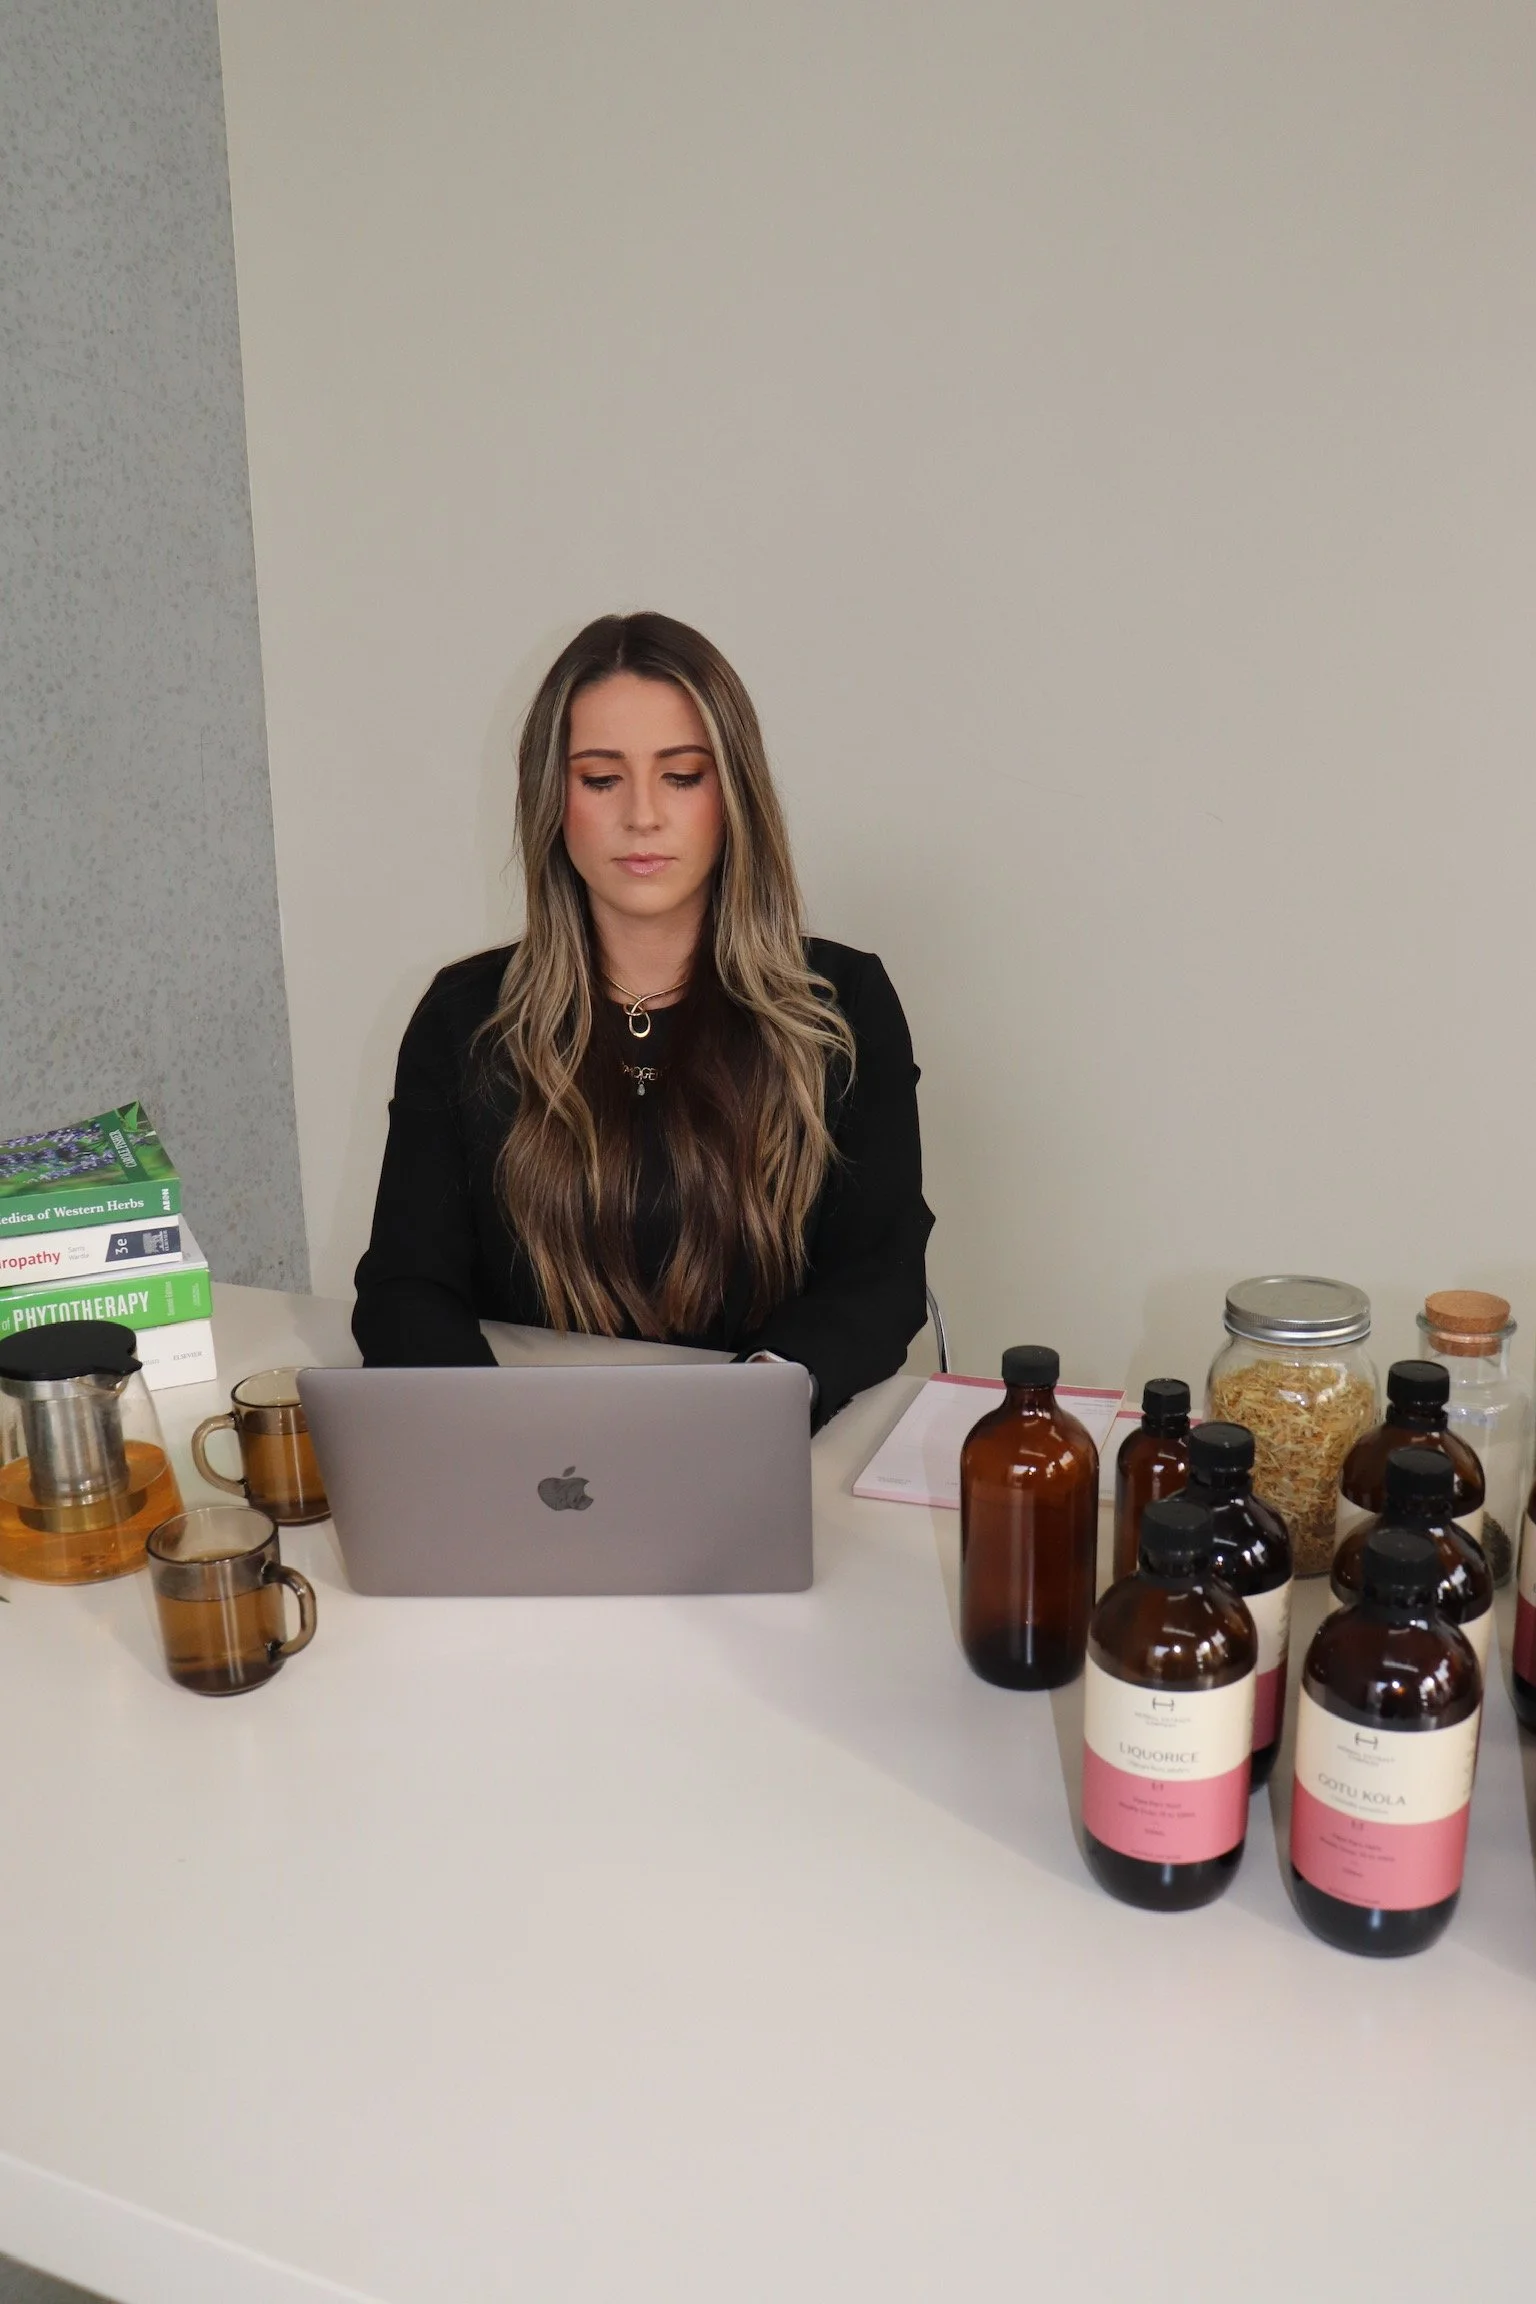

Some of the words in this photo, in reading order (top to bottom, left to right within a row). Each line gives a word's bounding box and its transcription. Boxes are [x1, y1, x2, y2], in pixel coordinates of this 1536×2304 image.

[0, 1212, 35, 1225] edica
[37, 1208, 51, 1220] of
[53, 1204, 104, 1218] Western
[107, 1198, 144, 1211] Herbs
[161, 1188, 171, 1211] AEON
[115, 1238, 129, 1256] 3e
[1, 1317, 11, 1331] of
[13, 1291, 149, 1332] PHYTOTHERAPY
[1119, 1741, 1199, 1764] LIQUORICE
[1318, 1772, 1358, 1798] GOTU
[1362, 1789, 1406, 1806] KOLA
